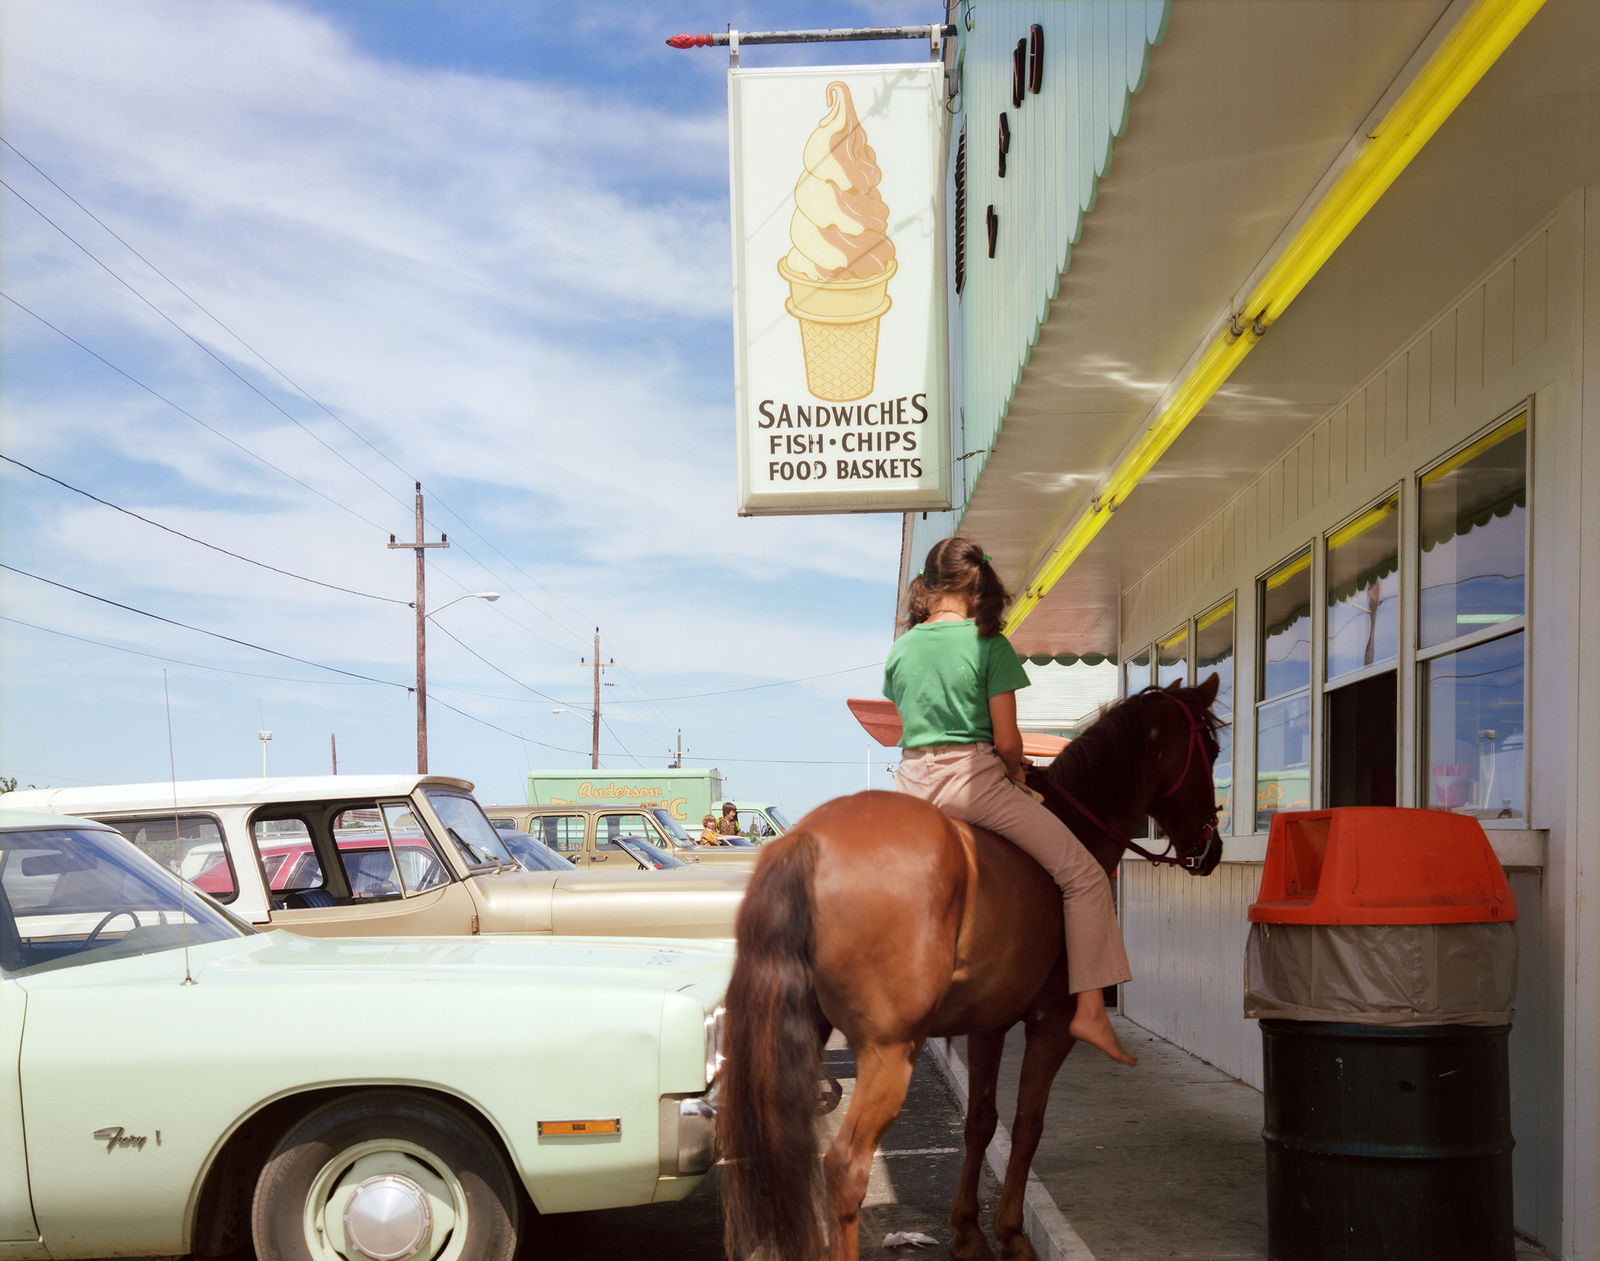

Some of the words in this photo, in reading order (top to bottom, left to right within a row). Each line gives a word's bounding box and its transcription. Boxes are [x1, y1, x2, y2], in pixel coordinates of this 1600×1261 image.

[758, 393, 928, 429] SANDWICHES
[769, 433, 824, 454] FISH
[841, 431, 917, 452] CHIPS
[769, 460, 828, 481] FOOD
[836, 457, 923, 480] BASKETS
[578, 782, 662, 799] Anderson
[93, 1126, 148, 1154] Fury
